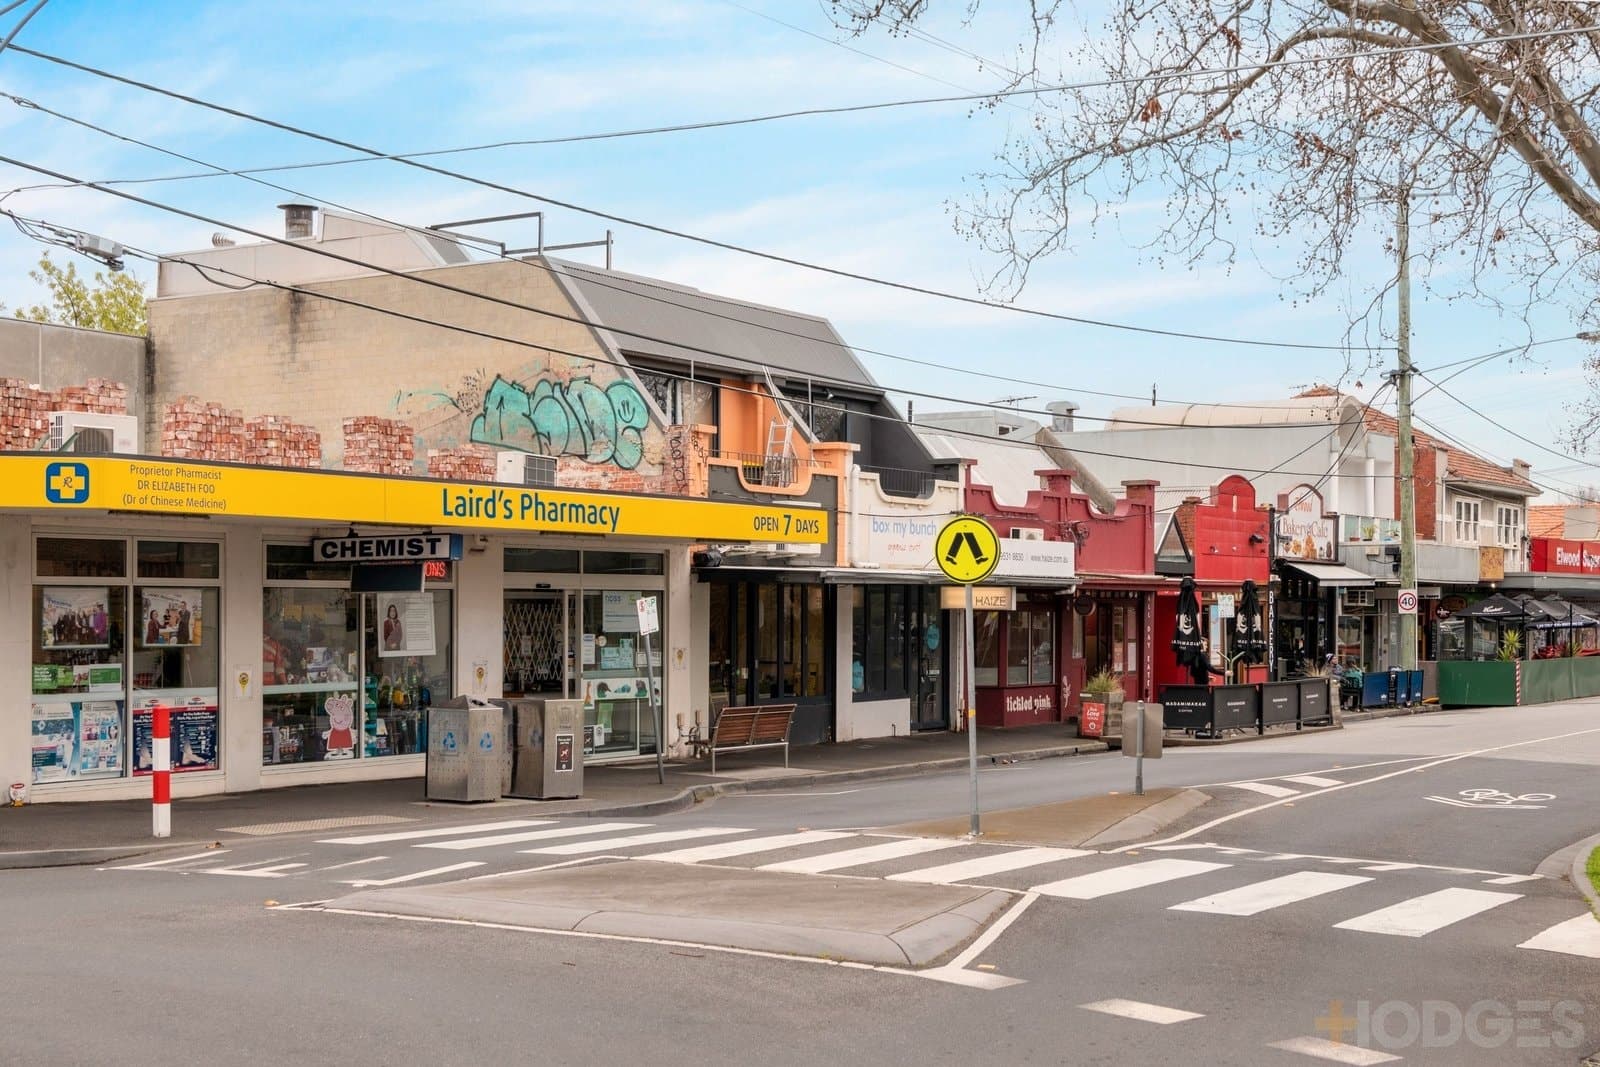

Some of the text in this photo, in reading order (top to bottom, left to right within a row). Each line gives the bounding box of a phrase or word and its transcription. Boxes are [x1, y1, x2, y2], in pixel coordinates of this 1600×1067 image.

[130, 464, 222, 480] Proprietor Pharmacist
[137, 479, 215, 494] DR ELIZABETH FOO
[123, 493, 227, 511] (Dr of Chinese Medicine)
[442, 488, 621, 533] Laird's Pharmacy
[753, 514, 820, 536] OPEN 7 DAYS
[872, 517, 937, 539] box my bunch
[1283, 517, 1306, 536] Bakery
[320, 537, 442, 559] CHEMIST
[1556, 546, 1581, 567] Elwood
[975, 595, 1007, 607] HAIZE
[1401, 596, 1415, 607] 40
[1006, 694, 1052, 715] tickled pink
